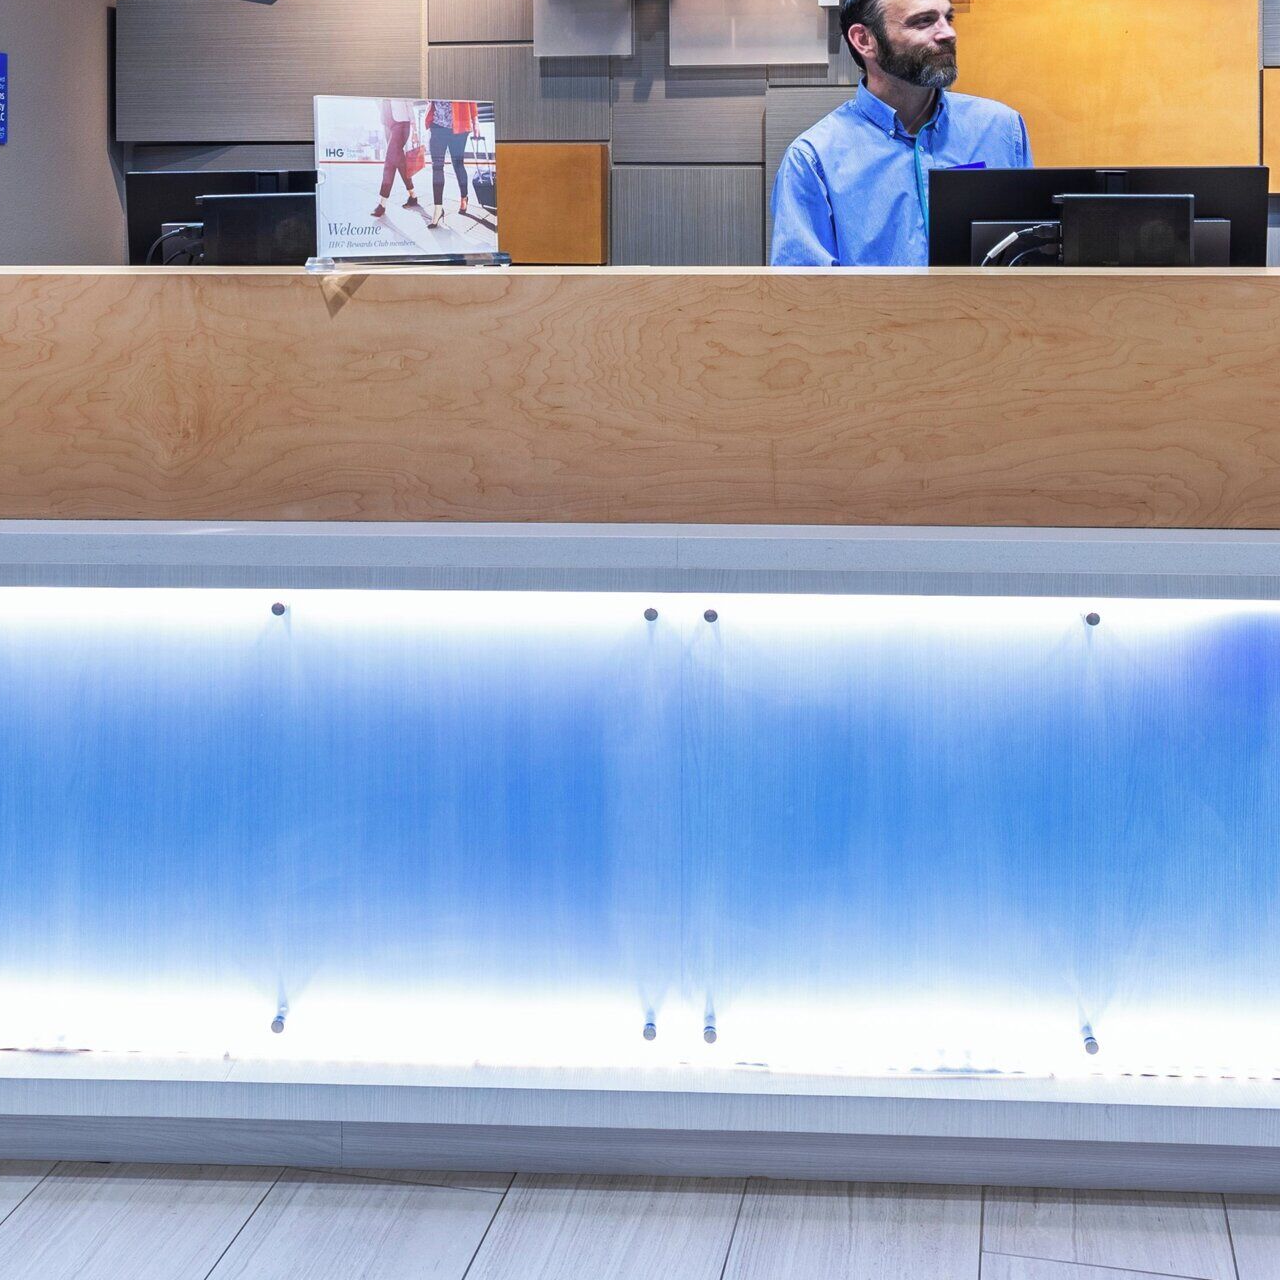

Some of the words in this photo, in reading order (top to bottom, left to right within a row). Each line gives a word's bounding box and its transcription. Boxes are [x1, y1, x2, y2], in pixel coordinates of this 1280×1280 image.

[325, 148, 344, 158] IHG
[328, 222, 382, 236] Welcome
[346, 240, 373, 249] Rewards
[373, 239, 389, 247] Club
[389, 239, 416, 247] members
